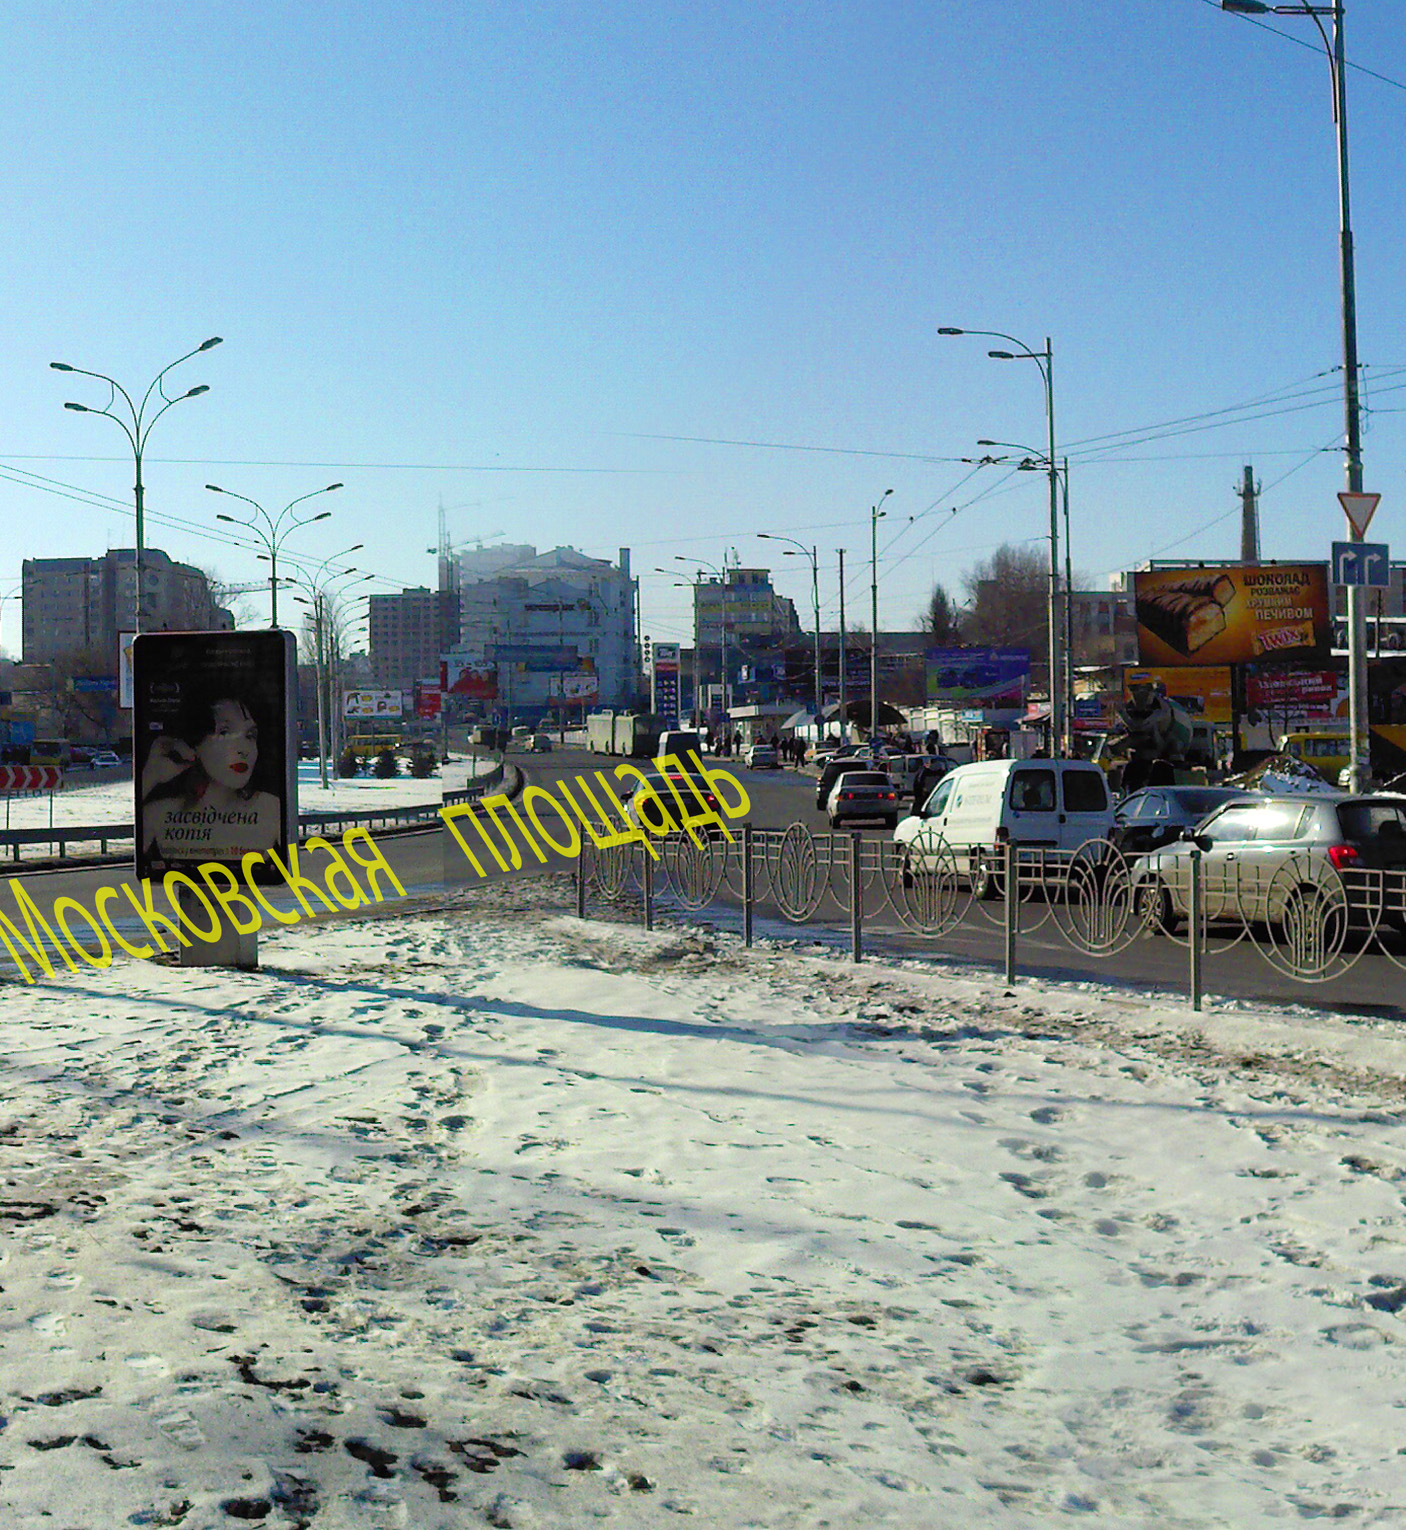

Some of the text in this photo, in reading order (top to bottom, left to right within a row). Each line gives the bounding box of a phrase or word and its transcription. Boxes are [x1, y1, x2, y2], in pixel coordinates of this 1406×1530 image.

[1243, 573, 1311, 586] ШОКОЛАД
[1256, 608, 1313, 621] ПЕЧИВОМ
[164, 805, 258, 825] засвідчена
[164, 827, 213, 842] копія
